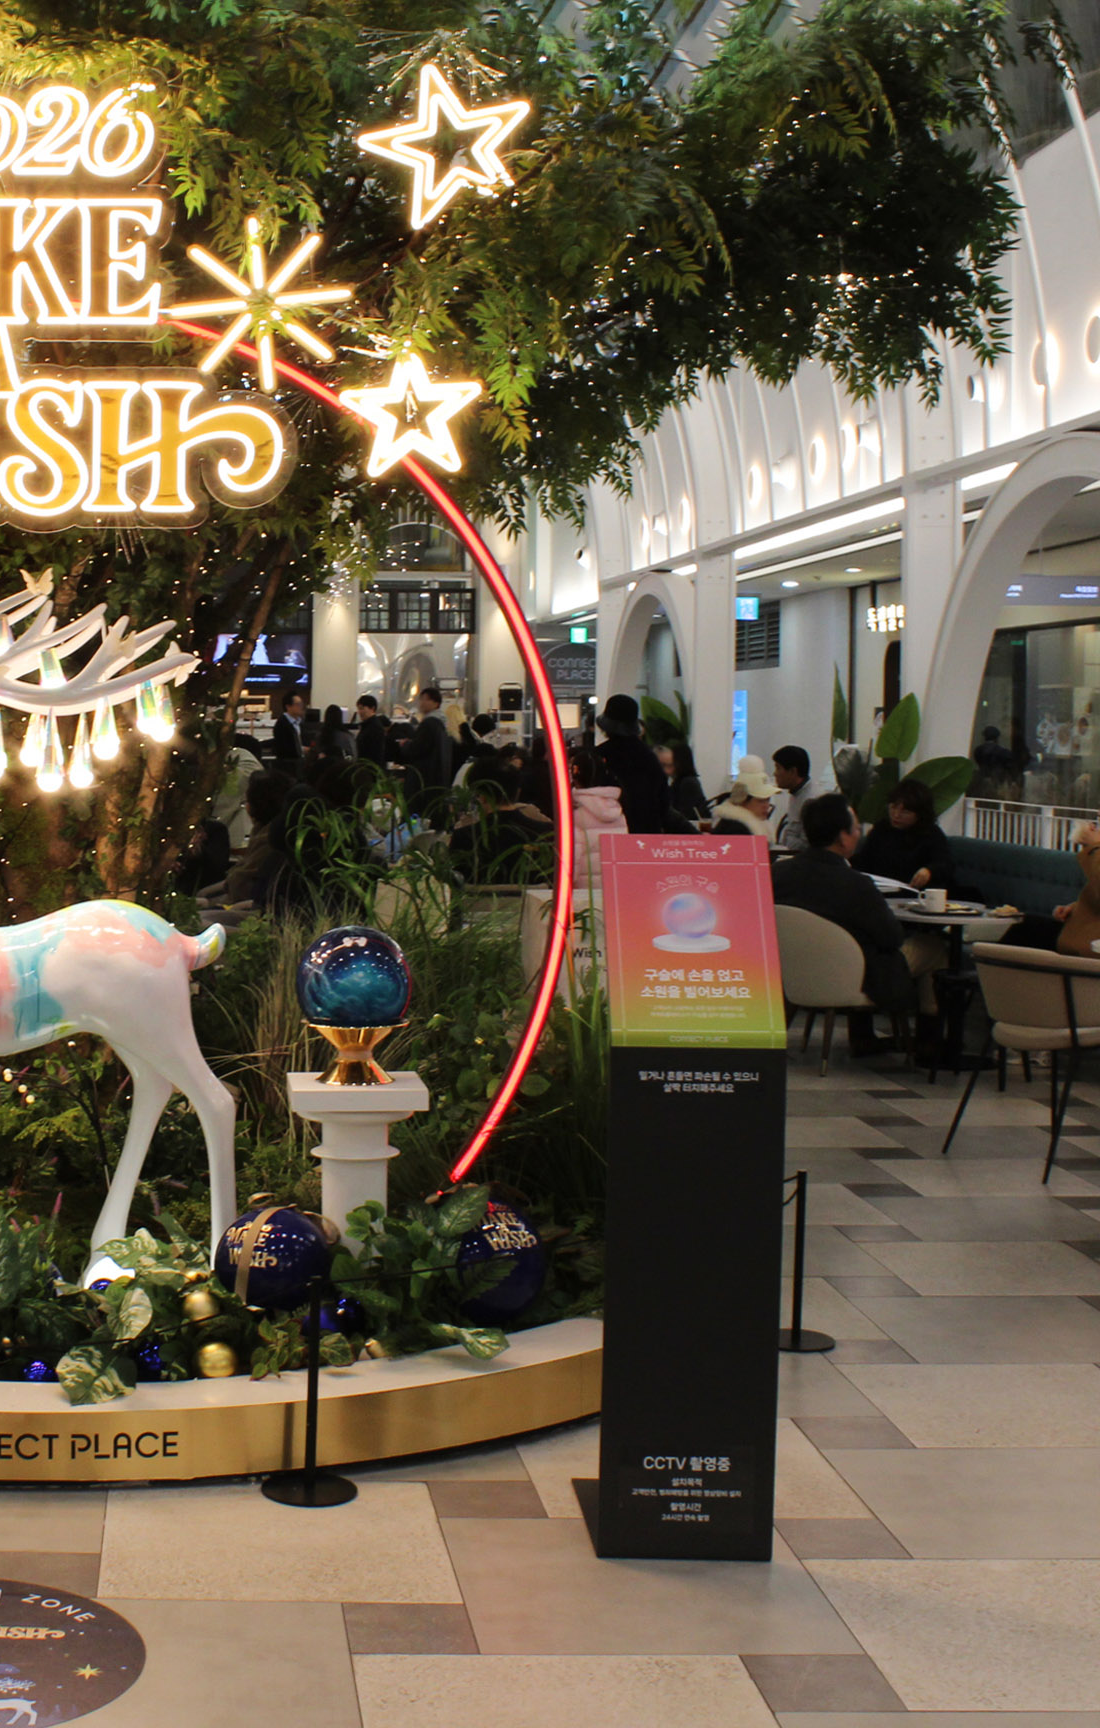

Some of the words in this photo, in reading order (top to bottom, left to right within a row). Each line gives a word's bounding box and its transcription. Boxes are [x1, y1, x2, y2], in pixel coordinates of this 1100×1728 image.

[547, 657, 597, 668] CONNEC
[651, 847, 684, 859] Wish
[686, 847, 718, 859] Tree
[644, 968, 685, 981] 구슬에
[688, 968, 715, 982] 손을
[640, 985, 681, 999] 소원을
[683, 985, 752, 999] 빌어보세요
[722, 1072, 732, 1081] 수
[70, 1430, 179, 1460] PLACE
[643, 1456, 687, 1470] CCTV
[689, 1456, 731, 1472] 촬영중
[21, 1593, 96, 1622] ZONE
